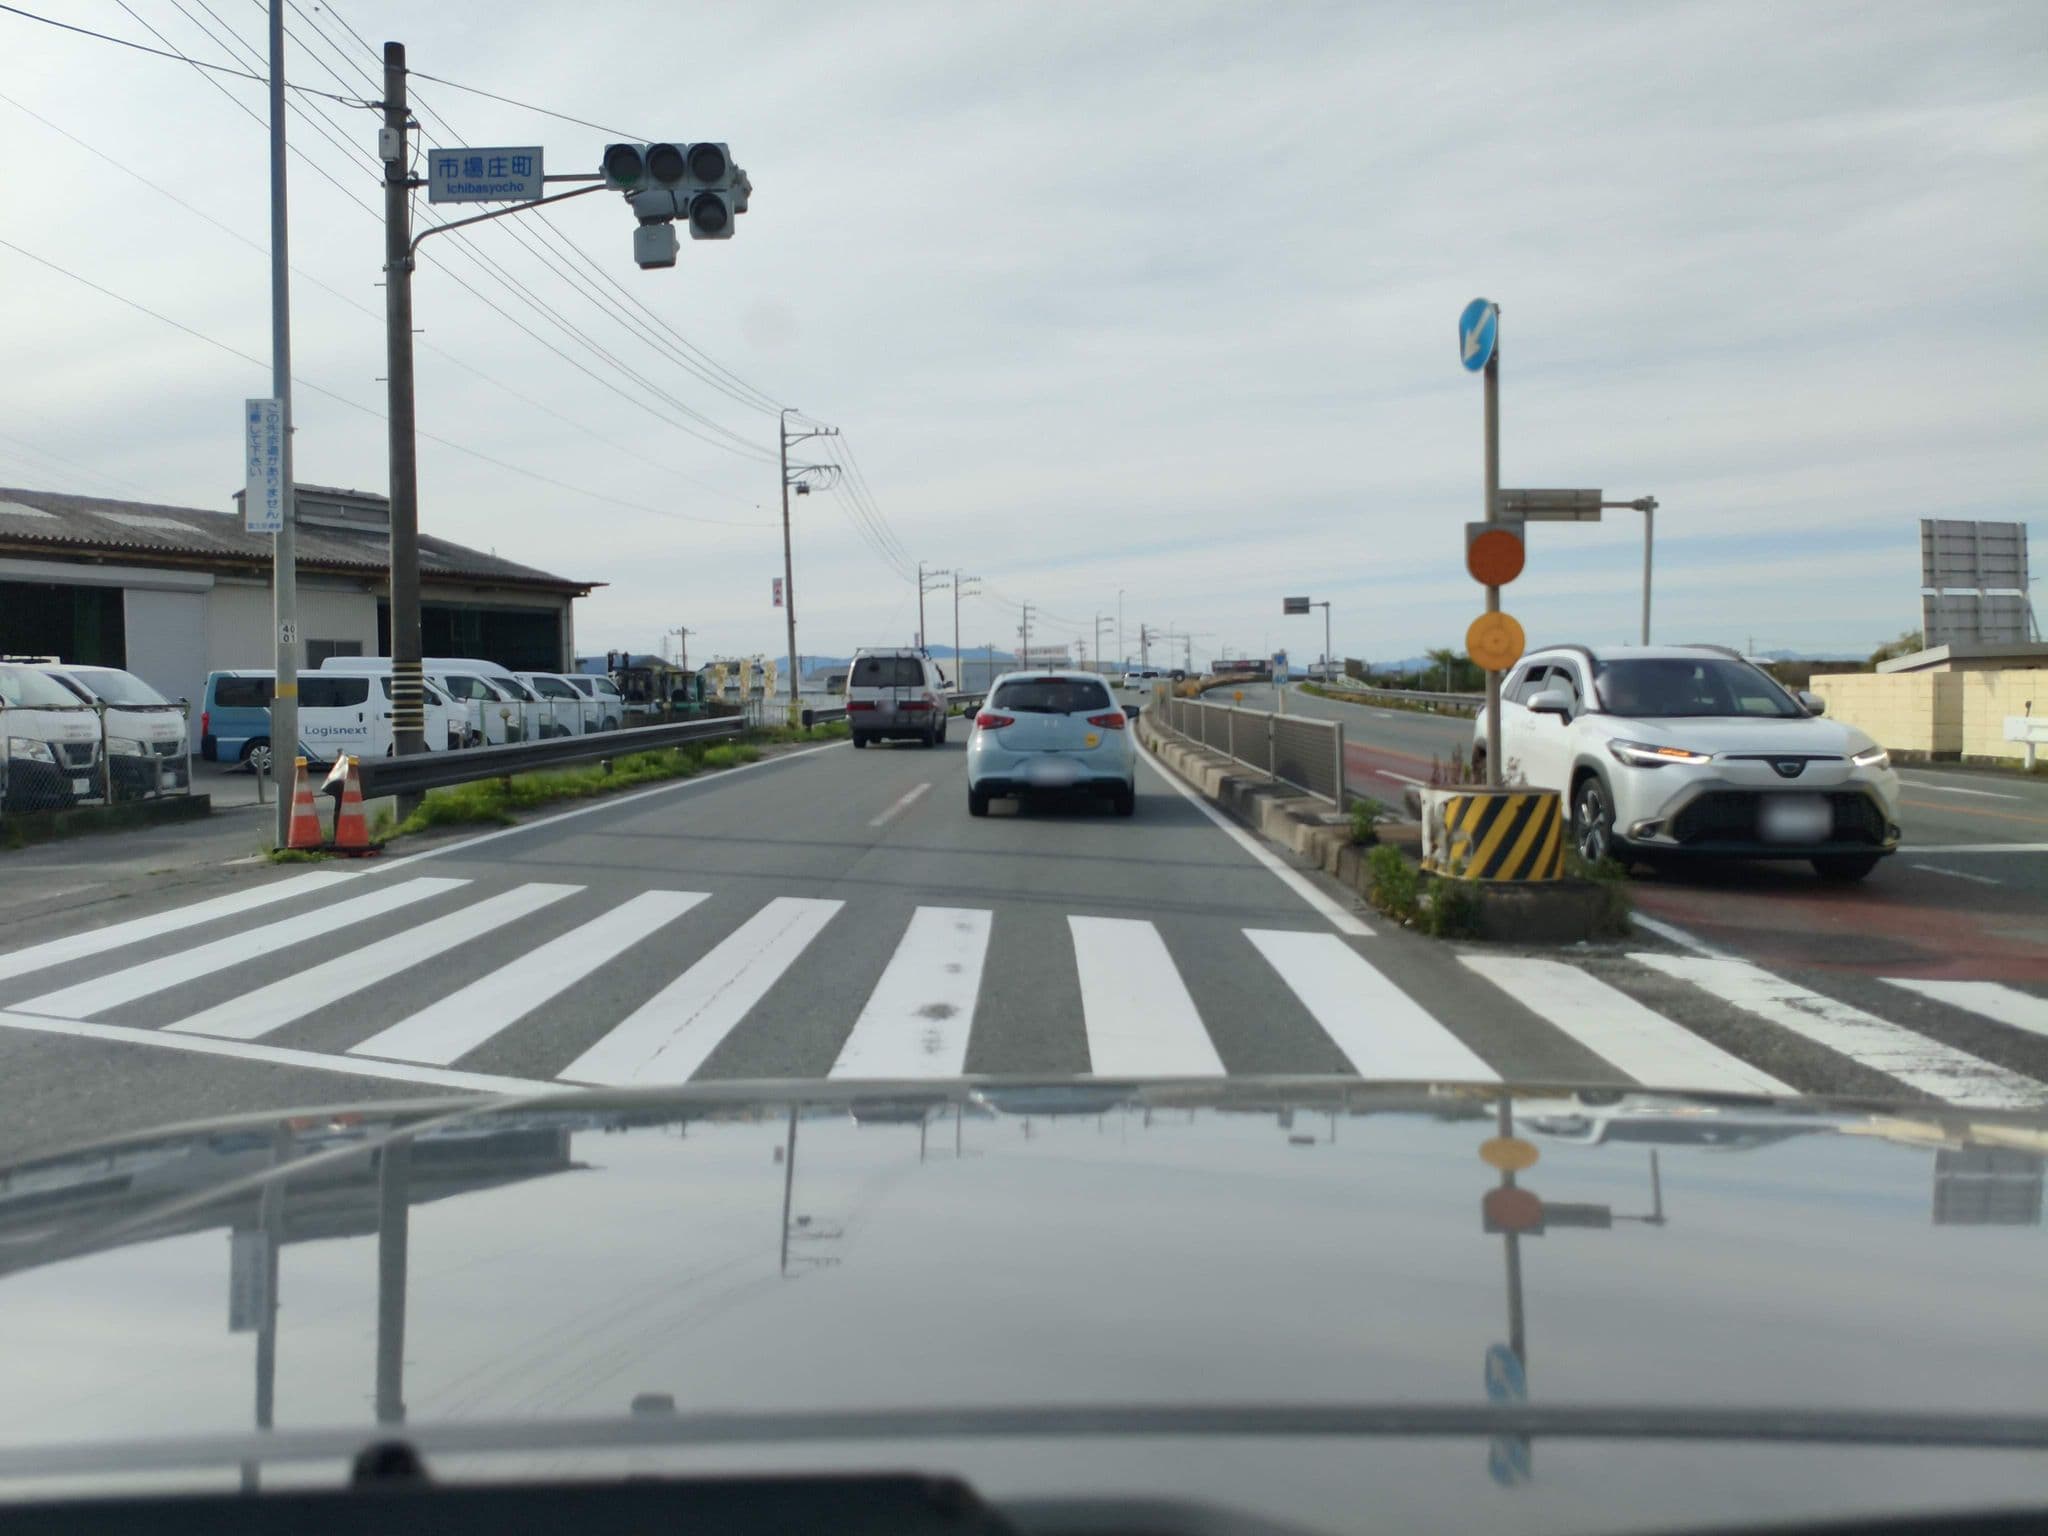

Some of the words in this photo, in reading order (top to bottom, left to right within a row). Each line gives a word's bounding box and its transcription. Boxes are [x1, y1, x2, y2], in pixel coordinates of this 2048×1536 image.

[438, 156, 532, 178] 市場庄町
[447, 181, 524, 195] Ichibasyocho
[304, 726, 368, 737] Logisnext
